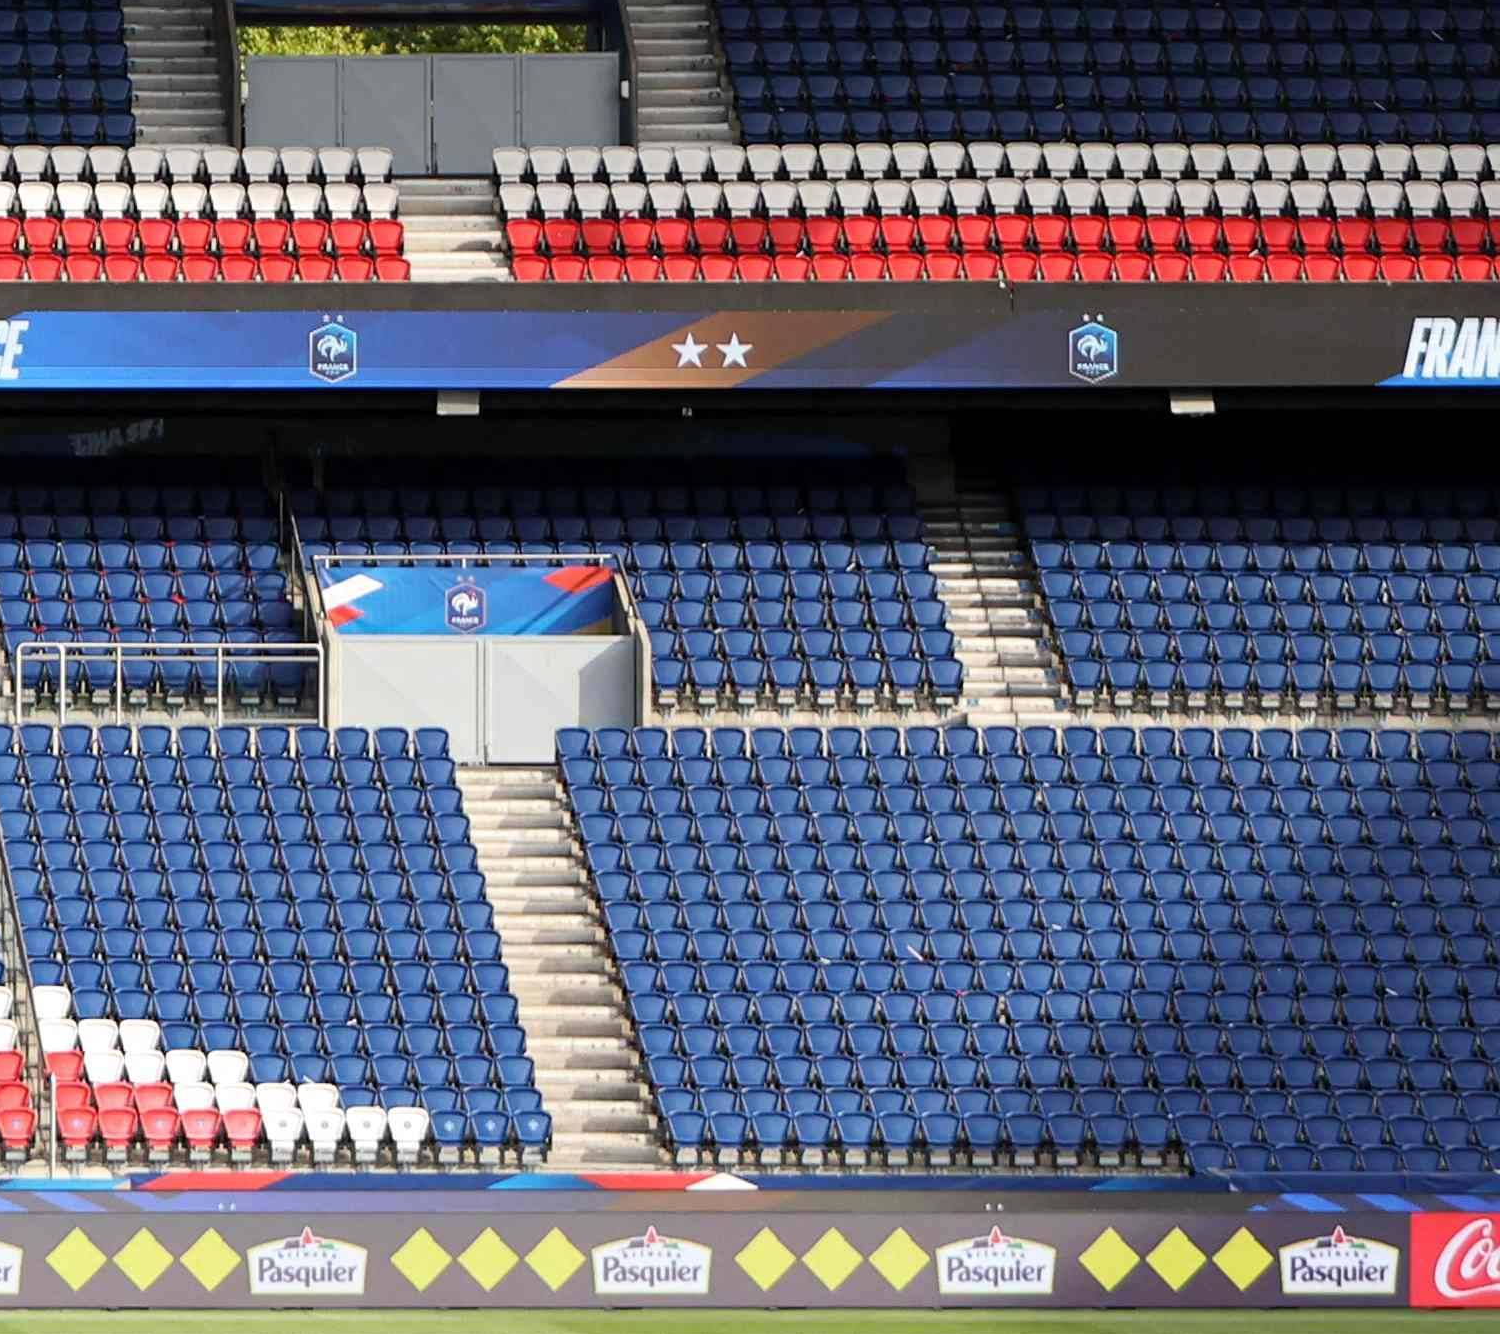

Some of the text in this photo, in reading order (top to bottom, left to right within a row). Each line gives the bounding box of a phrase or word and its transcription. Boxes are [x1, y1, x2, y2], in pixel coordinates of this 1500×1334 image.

[258, 1257, 358, 1288] Pasquier
[603, 1256, 702, 1287] Pasquier
[947, 1256, 1046, 1287] Pasquier
[1290, 1256, 1389, 1287] Pasquier
